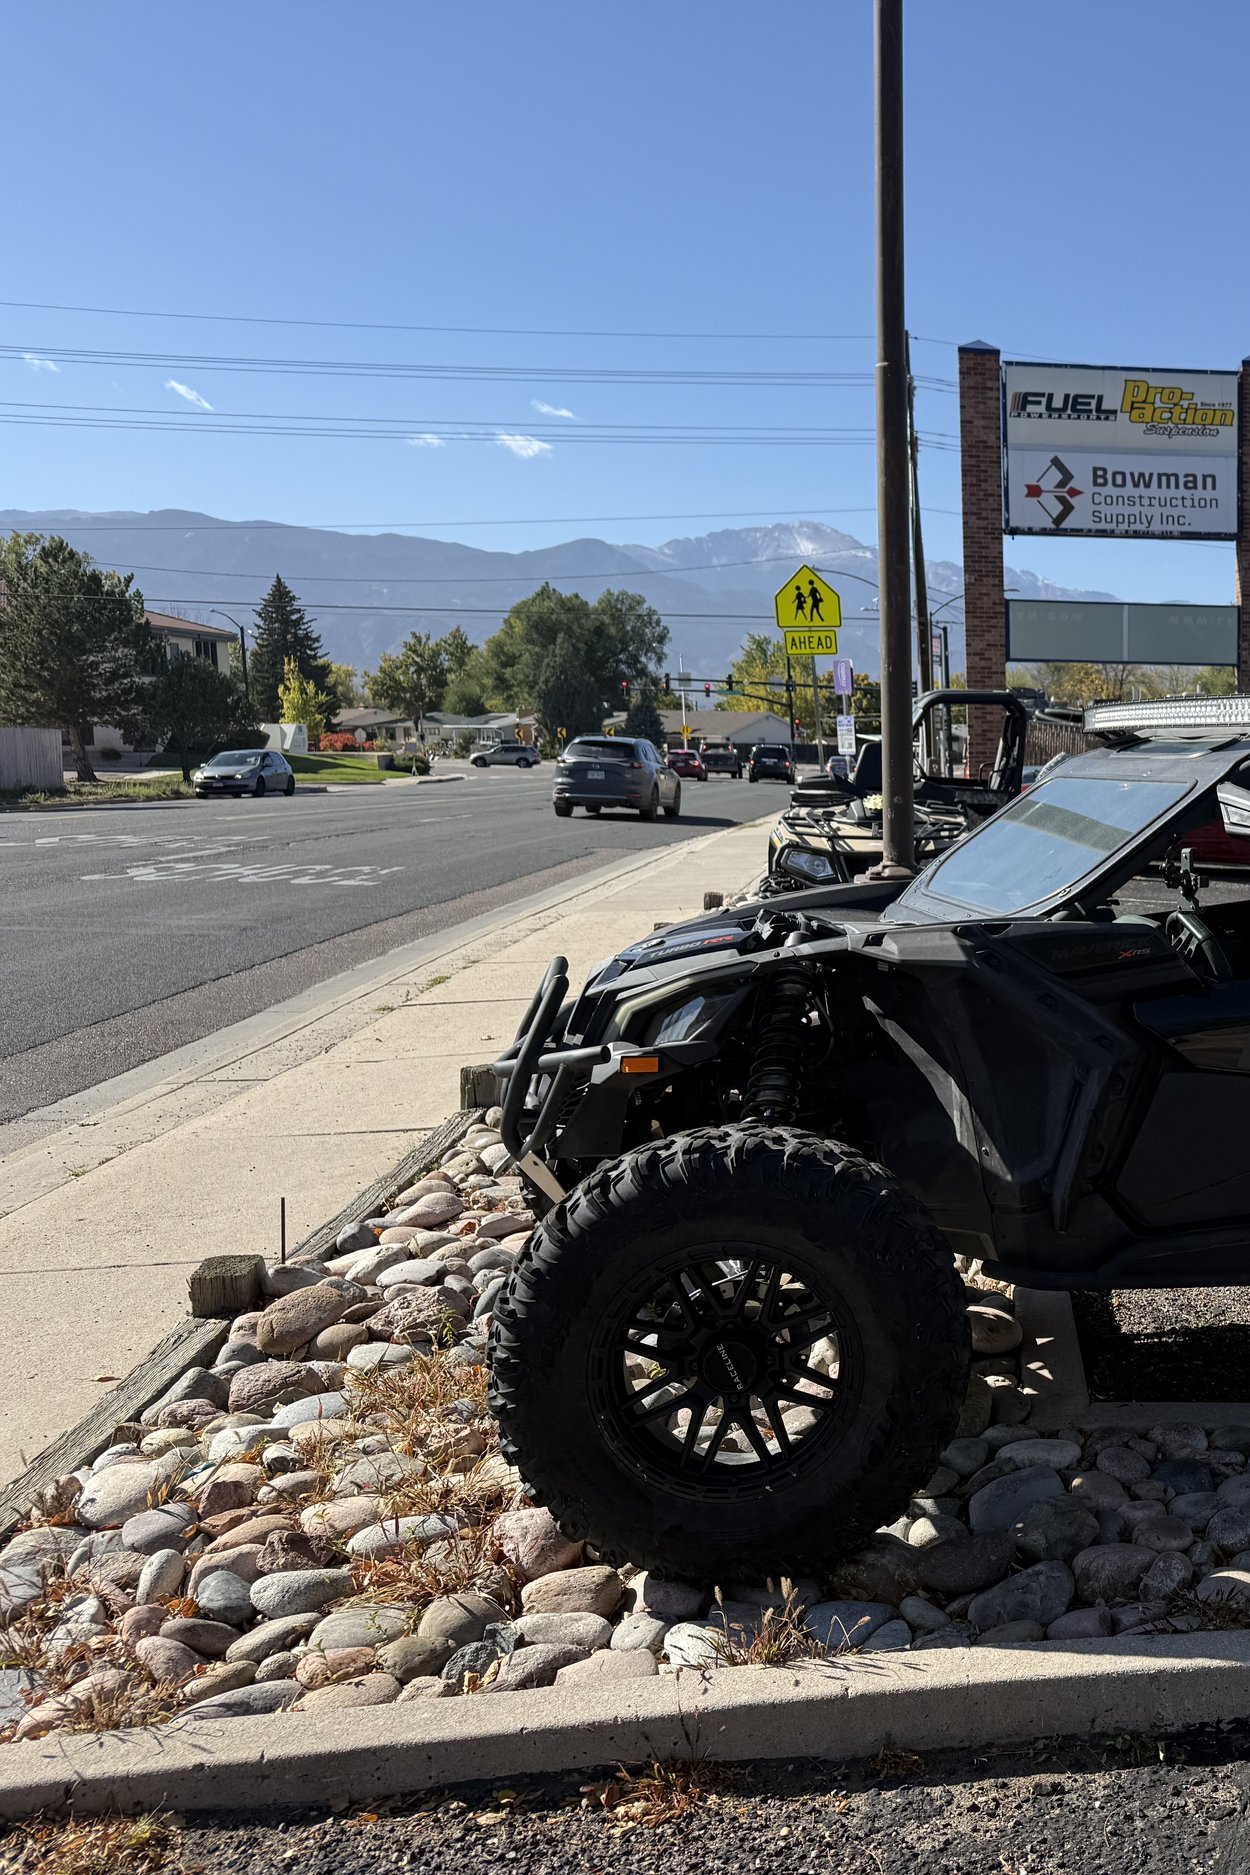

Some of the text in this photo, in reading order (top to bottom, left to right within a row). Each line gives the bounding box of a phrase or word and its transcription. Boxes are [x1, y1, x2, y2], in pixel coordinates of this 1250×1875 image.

[1019, 391, 1118, 415] FUEL
[1010, 411, 1117, 421] POWERSPORTS
[1129, 402, 1235, 426] action
[1143, 422, 1220, 439] Suspension
[1092, 466, 1217, 491] Bowman
[1092, 491, 1219, 509] Construction
[1092, 510, 1191, 529] Supply Inc.
[790, 636, 833, 650] AHEAD
[650, 941, 702, 959] TURBO
[716, 1343, 744, 1390] RACELINE
